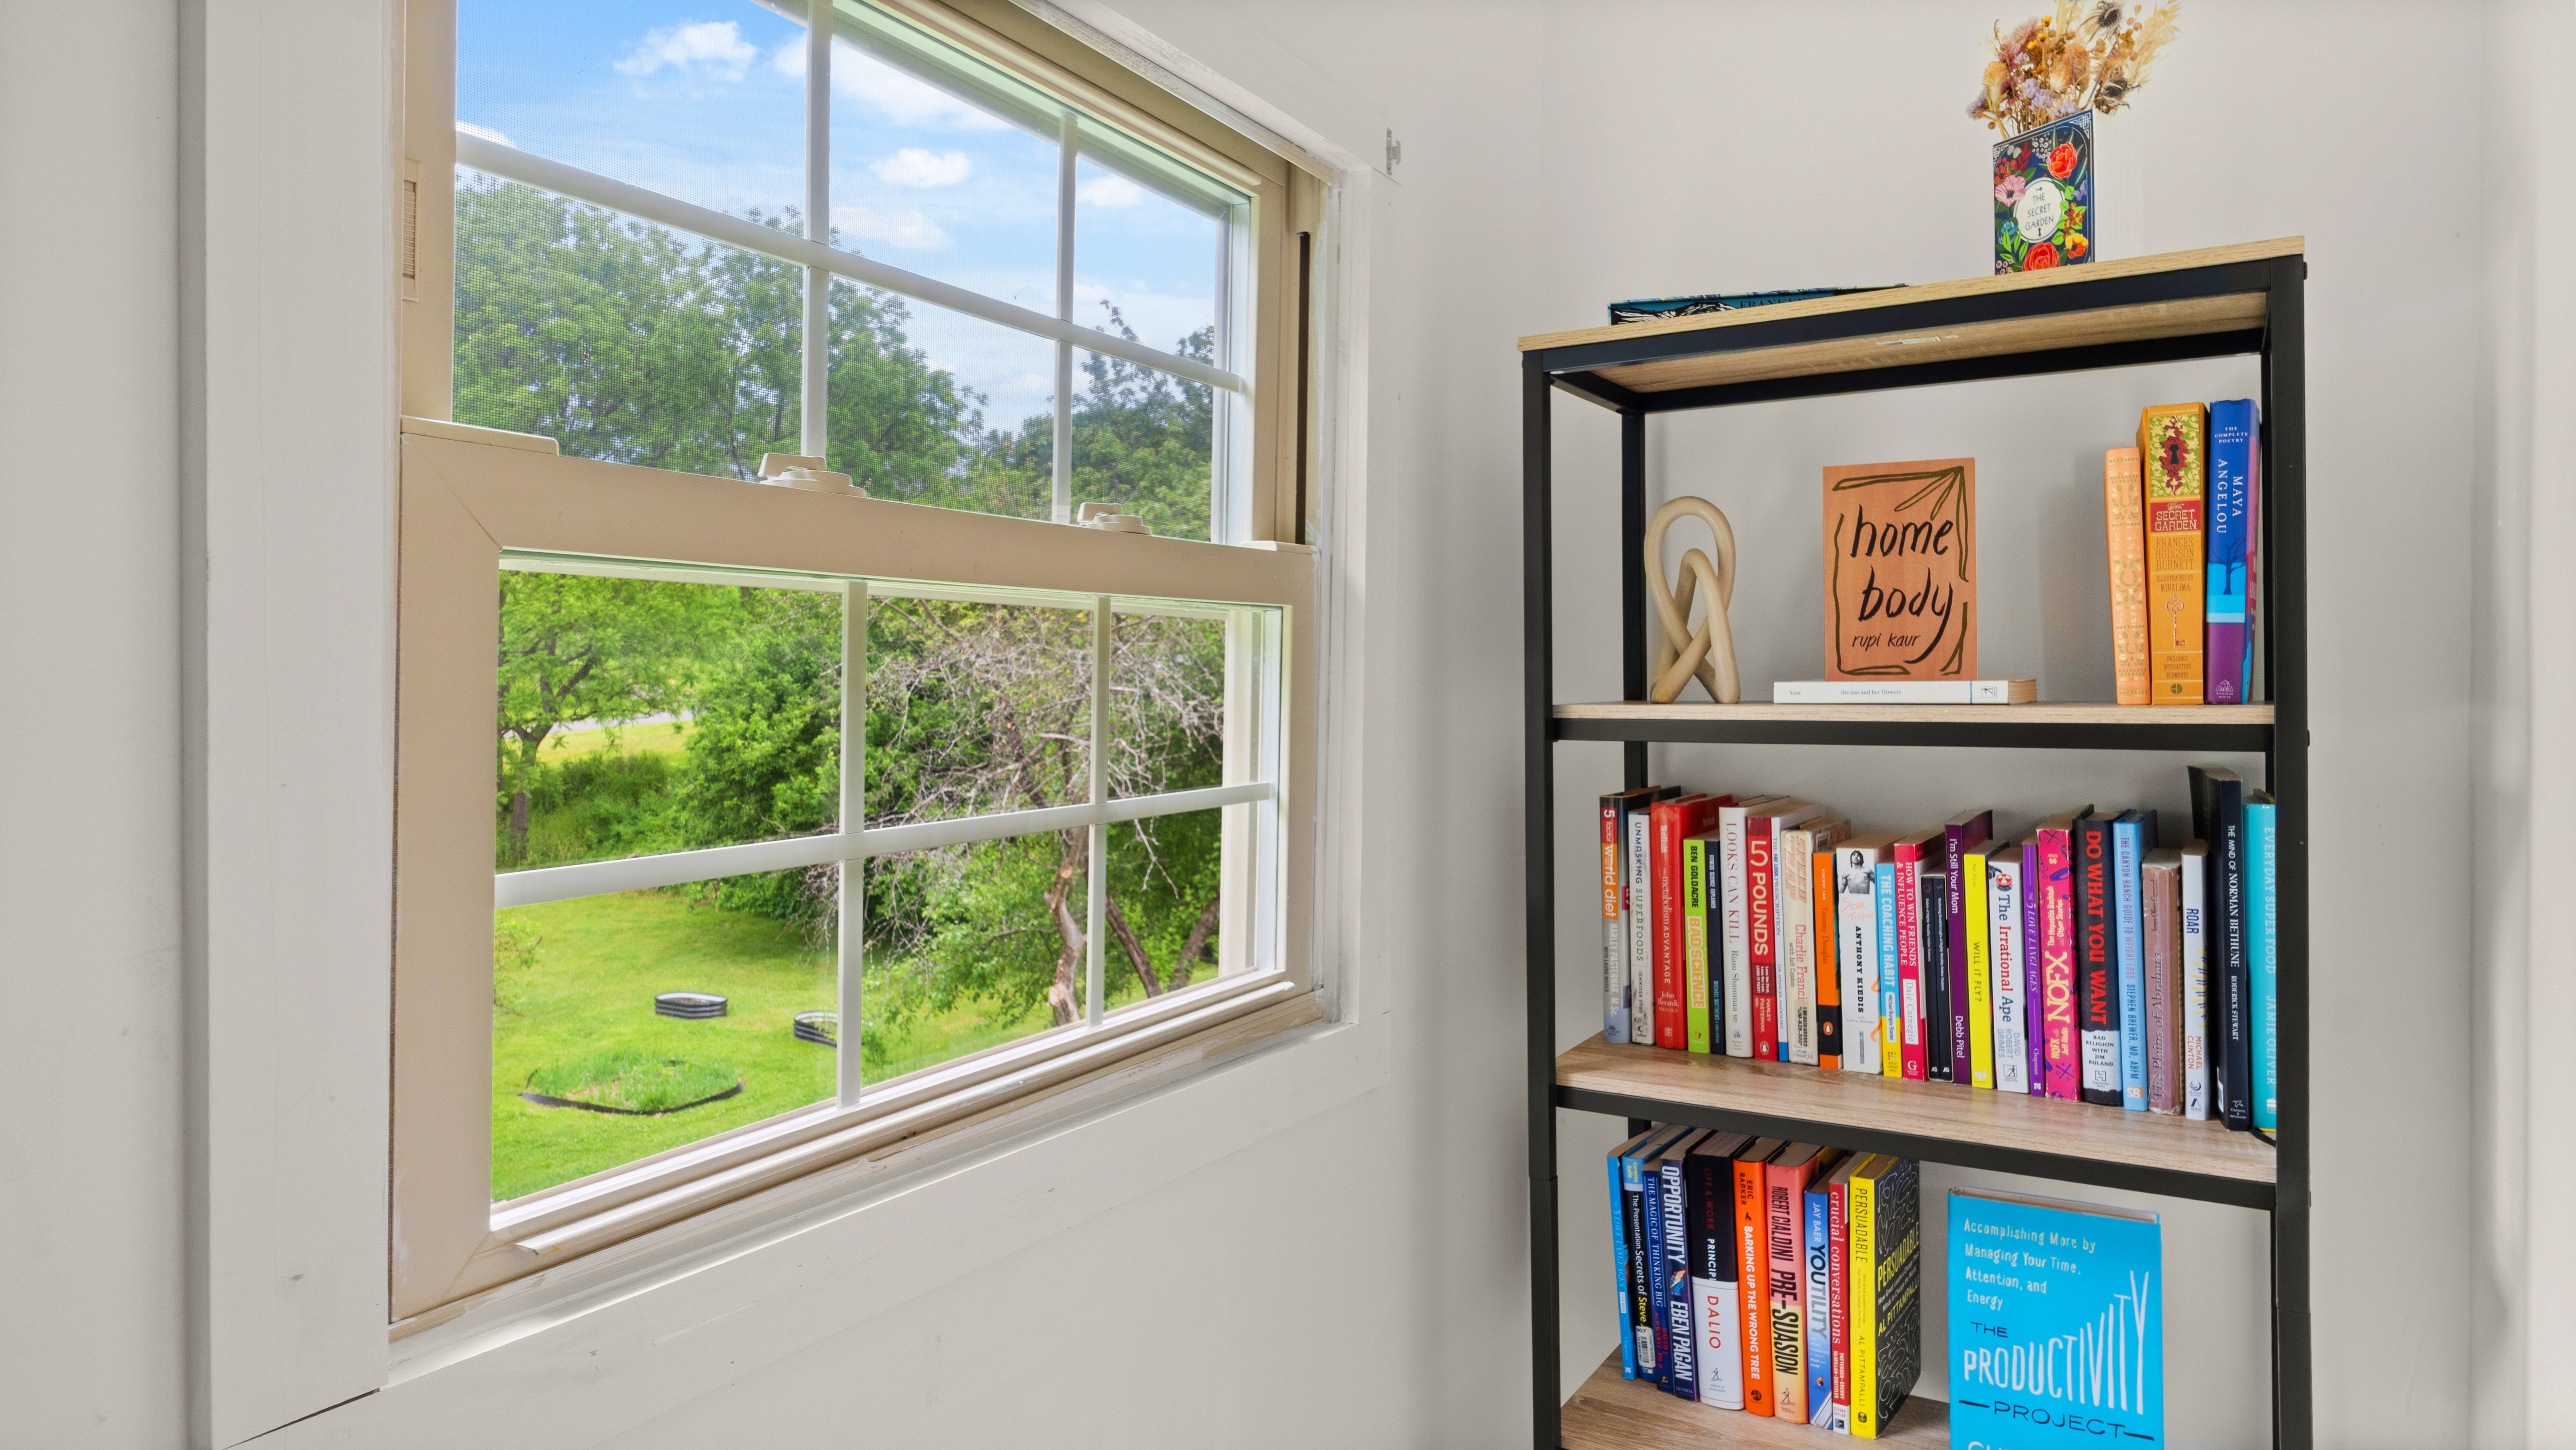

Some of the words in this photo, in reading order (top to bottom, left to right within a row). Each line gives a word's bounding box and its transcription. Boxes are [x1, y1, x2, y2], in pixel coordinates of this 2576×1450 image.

[2027, 203, 2051, 218] SECRET
[2033, 193, 2045, 204] THE
[2025, 215, 2054, 230] GARDEN
[2216, 459, 2228, 533] ANGELOU
[2233, 476, 2243, 517] MAYA
[1850, 504, 1953, 558] home
[2155, 520, 2197, 531] GARDEN
[2156, 509, 2195, 521] SECRET
[2156, 537, 2193, 547] FRANCES
[2156, 548, 2194, 559] HODGSON
[2156, 559, 2194, 570] BURNETT
[2161, 583, 2190, 592] MINALIMA
[1858, 565, 1953, 664] body
[1852, 633, 1881, 652] rupi
[1888, 633, 1921, 647] kaur
[1726, 822, 1738, 870] LOOKS
[1750, 841, 1768, 866] 5
[2086, 831, 2102, 859] DO
[2264, 827, 2275, 893] EVERYDAY
[2229, 860, 2236, 871] OF
[1728, 876, 1739, 904] CAN
[1881, 874, 1892, 895] THE
[1897, 872, 1906, 927] INFLUENCE
[1906, 888, 1913, 900] TO
[2087, 863, 2104, 917] WHAT
[2229, 873, 2238, 917] NORMAN
[1752, 872, 1769, 955] POUNDS
[1882, 898, 1894, 952] COACHING
[1998, 895, 2010, 921] The
[2186, 908, 2199, 934] ROAR
[2265, 896, 2275, 935] SUPER
[1688, 916, 1702, 947] BAD
[1728, 910, 1739, 943] KILL
[2088, 923, 2105, 962] YOU
[2230, 919, 2240, 968] BETHUNE
[1908, 924, 1916, 967] FRIENDS
[1999, 926, 2013, 991] Irrational
[2266, 939, 2275, 974] FOOD
[1690, 948, 1706, 1008] SCIENCE
[1884, 954, 1895, 987] HABIT
[2045, 951, 2070, 1023] NOFX
[2151, 952, 2163, 1011] Abraham
[1999, 996, 2013, 1022] Ape
[2090, 970, 2106, 1025] WANT
[2266, 995, 2276, 1034] JAMIE
[1906, 1004, 1915, 1042] Carnegie
[1956, 1016, 1964, 1038] Debb
[2152, 1012, 2163, 1028] of
[1956, 1040, 1965, 1058] Pitel
[2152, 1032, 2164, 1070] Plains
[2266, 1039, 2276, 1084] OLIVER
[2153, 1074, 2164, 1100] The
[1648, 1197, 1657, 1227] MAGIC
[1662, 1166, 1686, 1265] OPPORTUNITY
[1831, 1192, 1844, 1242] crucial
[1855, 1188, 1867, 1263] PERSUADABLE
[1651, 1228, 1658, 1241] OF
[1744, 1226, 1755, 1272] BARKING
[1964, 1218, 2044, 1246] Accomplishing
[2050, 1232, 2077, 1249] More
[2083, 1237, 2095, 1253] by
[1635, 1250, 1644, 1283] Secrets
[1652, 1244, 1662, 1290] THINKING
[1878, 1222, 1919, 1292] PERSUADABLE
[1965, 1243, 2019, 1267] Managing
[2023, 1252, 2047, 1268] Your
[2050, 1257, 2081, 1275] Time,
[1638, 1286, 1647, 1296] of
[1746, 1274, 1756, 1289] UP
[1831, 1246, 1844, 1344] conversations
[1965, 1266, 2022, 1291] Attention,
[2027, 1281, 2047, 1294] and
[1639, 1297, 1647, 1322] Steve
[1747, 1290, 1757, 1310] THE
[1968, 1289, 2003, 1311] Energy
[1671, 1301, 1690, 1336] EBEN
[1707, 1296, 1721, 1349] DALIO
[1749, 1312, 1759, 1353] WRONG
[1970, 1321, 2008, 1338] THE
[1673, 1336, 1693, 1381] PAGAN
[1964, 1270, 2149, 1415] PRODUCTIVITY
[1750, 1355, 1760, 1380] TREE
[1994, 1401, 2126, 1438] PROJECT
